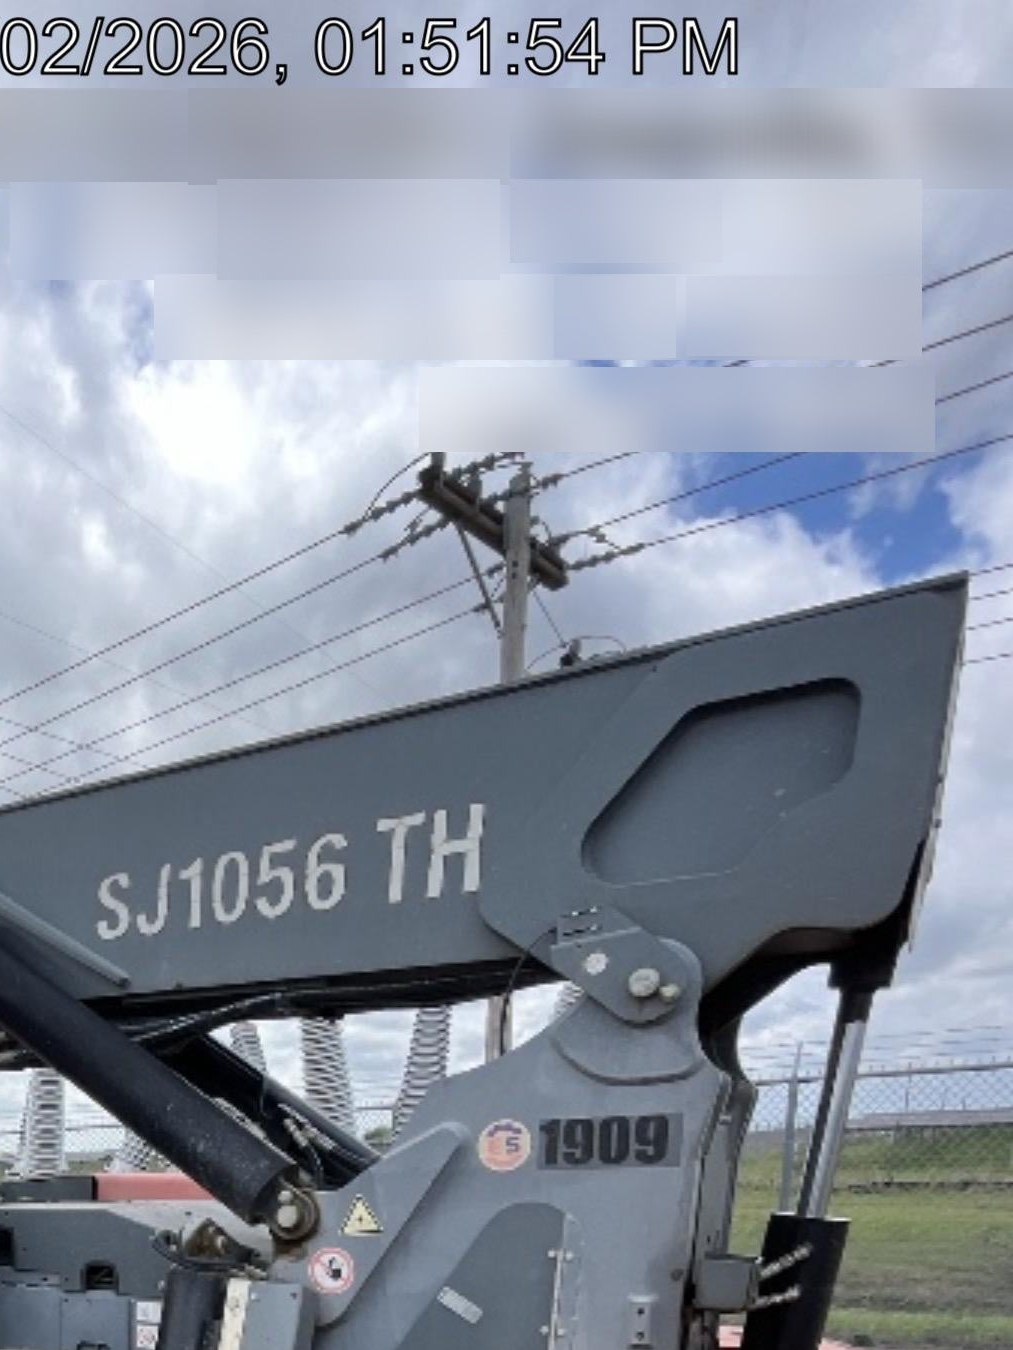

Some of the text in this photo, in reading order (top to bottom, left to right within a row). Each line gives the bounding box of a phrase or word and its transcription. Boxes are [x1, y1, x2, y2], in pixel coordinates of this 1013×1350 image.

[96, 803, 485, 940] SJ1056 TH
[539, 1115, 670, 1166] 1909
